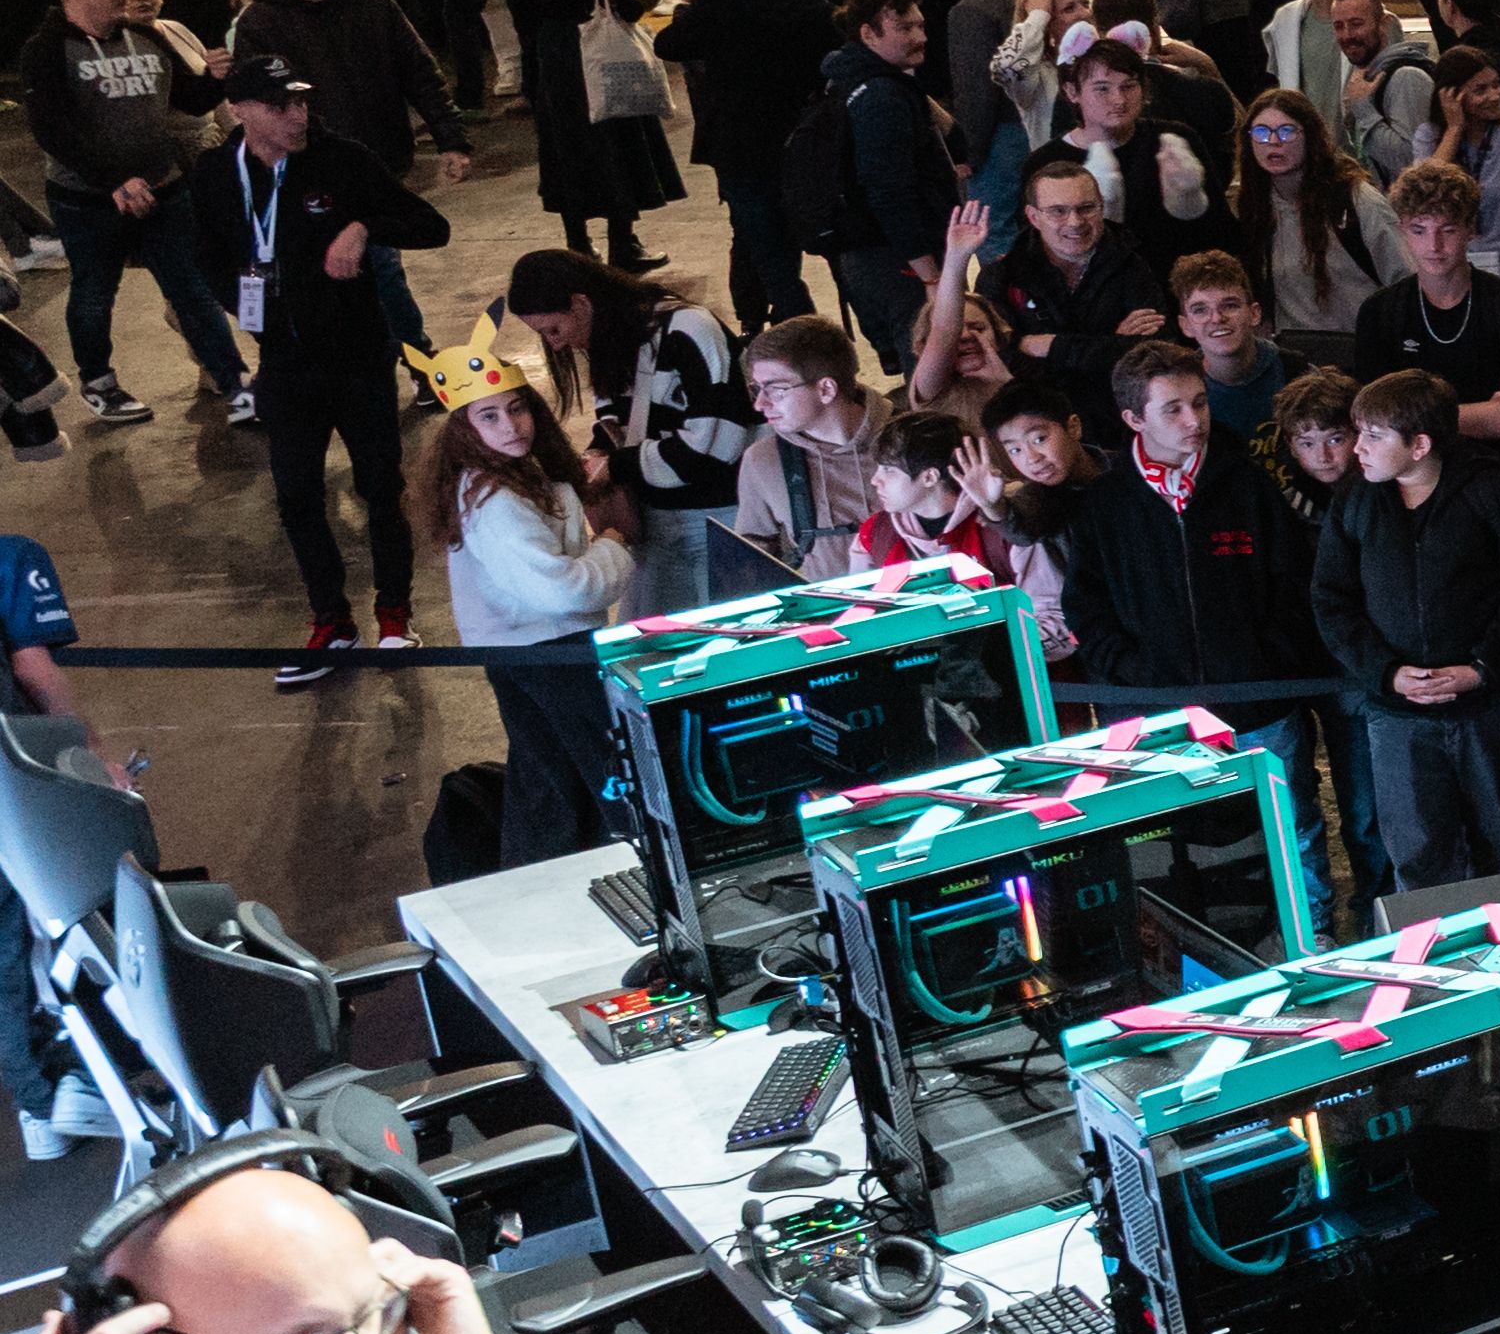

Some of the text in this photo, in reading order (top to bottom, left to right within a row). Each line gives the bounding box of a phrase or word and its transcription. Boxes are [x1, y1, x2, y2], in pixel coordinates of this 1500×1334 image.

[78, 53, 165, 81] SUPER
[99, 73, 158, 99] DRY
[809, 670, 860, 690] MIKU
[1031, 850, 1085, 870] MIKU
[1315, 1085, 1374, 1111] MIKU
